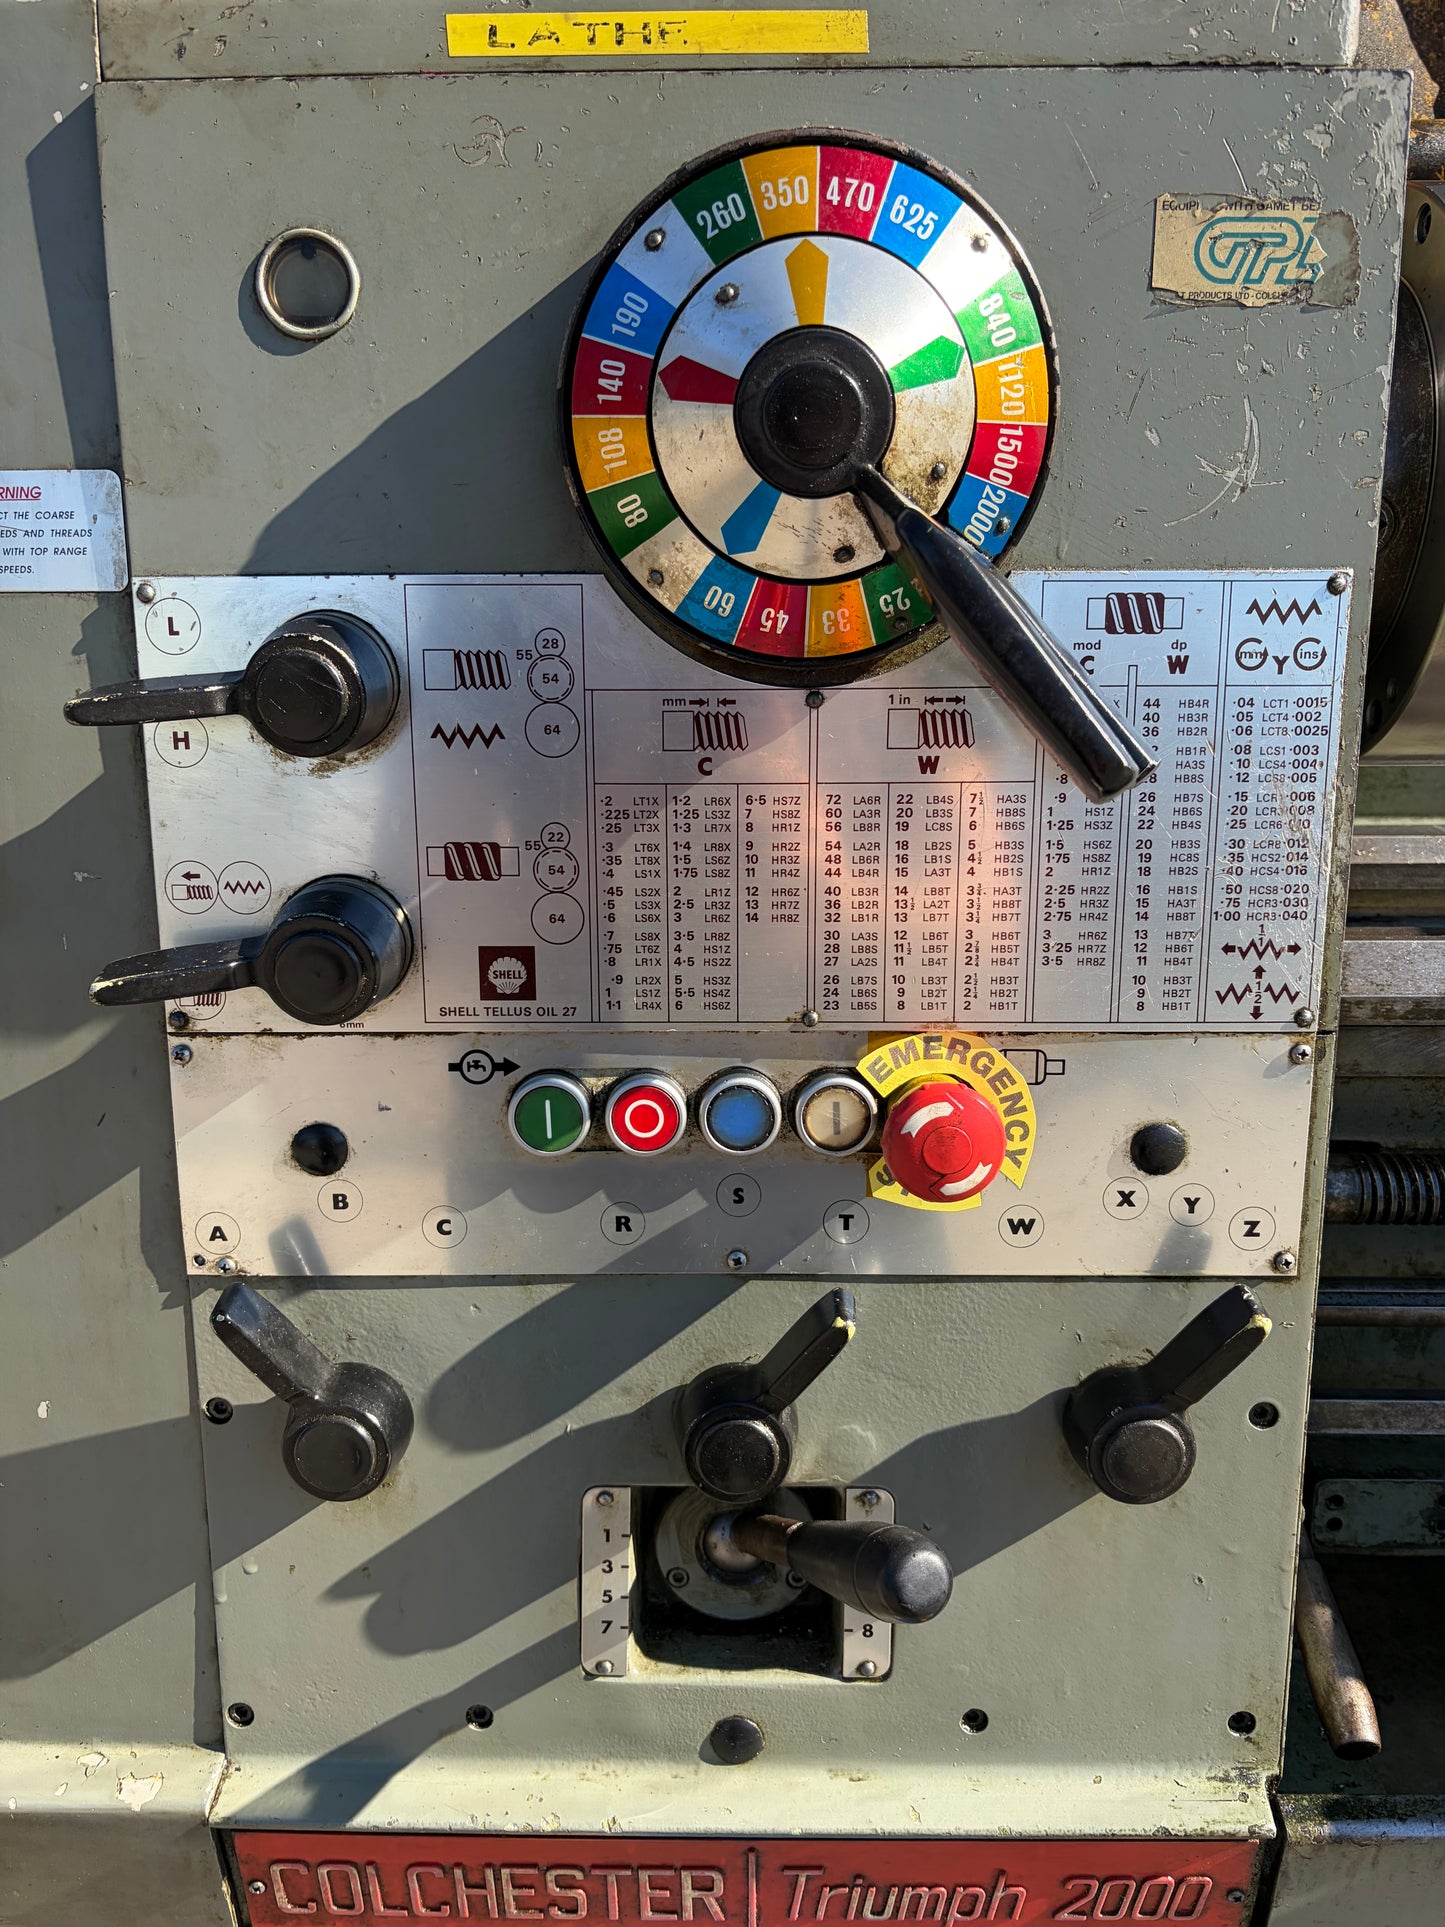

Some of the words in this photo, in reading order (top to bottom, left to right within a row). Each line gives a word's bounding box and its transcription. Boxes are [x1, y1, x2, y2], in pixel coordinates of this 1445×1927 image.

[760, 176, 809, 210] 350
[826, 176, 875, 212] 470
[696, 193, 746, 239] 260
[889, 194, 939, 240] 625
[611, 291, 649, 337] 190
[978, 292, 1017, 347] 840
[597, 359, 626, 405] 140
[997, 356, 1026, 416] 1120
[597, 427, 628, 474] 108
[988, 422, 1024, 487] 1500
[13, 511, 29, 520] THE
[35, 511, 75, 520] COARSE
[616, 493, 649, 529] 80
[963, 484, 1007, 547] 2000
[23, 529, 45, 538] AND
[51, 529, 93, 538] THREADS
[3, 547, 25, 556] WITH
[30, 547, 48, 556] TOP
[53, 547, 87, 556] RANGE
[703, 585, 736, 618] 60
[879, 587, 911, 619] 25
[168, 617, 180, 636] L
[759, 608, 789, 635] 45
[822, 608, 851, 635] 33
[542, 638, 559, 649] 28
[1073, 640, 1101, 650] mod
[1171, 639, 1187, 652] dp
[516, 649, 533, 660] 55
[1300, 649, 1318, 659] ins
[1167, 655, 1189, 674] W
[1272, 656, 1290, 675] Y
[543, 673, 559, 684] 54
[662, 698, 686, 706] mm
[889, 694, 894, 705] 1
[899, 694, 910, 704] in
[1143, 698, 1161, 709] 44
[1179, 699, 1209, 708] HB4R
[1263, 699, 1288, 708] LCT1
[544, 724, 561, 735] 64
[172, 731, 190, 750] H
[698, 757, 712, 776] C
[918, 756, 940, 774] W
[826, 794, 841, 805] 72
[853, 796, 881, 805] LA6R
[897, 794, 913, 804] 22
[927, 795, 953, 805] LB4S
[634, 809, 660, 819] LT2X
[705, 810, 731, 819] LS3Z
[745, 809, 752, 819] 7
[773, 810, 800, 819] HS8Z
[826, 808, 842, 818] 60
[853, 809, 880, 818] LA3R
[969, 807, 976, 817] 7
[996, 808, 1025, 817] HB8S
[1138, 806, 1155, 816] 24
[1173, 807, 1202, 816] HB6S
[634, 823, 660, 832] LT3X
[746, 822, 753, 832] 8
[772, 823, 800, 832] HR1Z
[548, 832, 564, 842] 22
[525, 840, 541, 851] 55
[895, 840, 909, 850] 18
[925, 841, 952, 851] LB2S
[968, 840, 976, 850] 5
[995, 841, 1024, 850] HB3S
[1136, 839, 1152, 849] 20
[1171, 840, 1200, 849] HB3S
[745, 854, 758, 864] 10
[772, 855, 800, 865] HR3Z
[548, 865, 565, 875] 54
[1045, 867, 1053, 877] 2
[1082, 867, 1111, 876] HR1Z
[673, 886, 681, 896] 2
[705, 888, 731, 897] LR1Z
[745, 886, 759, 896] 12
[772, 888, 800, 897] HR6Z
[1249, 885, 1278, 895] HCS8
[549, 914, 565, 923] 64
[674, 912, 682, 922] 3
[705, 914, 730, 923] LR6Z
[745, 913, 759, 922] 14
[772, 914, 800, 923] HR8Z
[824, 913, 841, 923] 32
[852, 913, 879, 922] LB1R
[894, 930, 907, 940] 12
[923, 932, 949, 940] LB6T
[965, 929, 973, 939] 3
[992, 932, 1021, 940] HB6T
[674, 944, 682, 953] 4
[704, 945, 731, 954] HS1Z
[1077, 957, 1106, 966] HR8Z
[493, 970, 524, 979] SHELL
[892, 975, 905, 984] 10
[922, 976, 948, 985] LB3T
[1132, 975, 1146, 985] 10
[1164, 976, 1192, 985] HB3T
[605, 988, 610, 997] 1
[636, 989, 661, 998] LS1Z
[823, 988, 839, 997] 24
[851, 989, 877, 998] LB6S
[636, 1002, 662, 1010] LR4X
[675, 1000, 683, 1010] 6
[704, 1002, 731, 1010] HS6Z
[963, 1001, 971, 1010] 2
[990, 1002, 1018, 1010] HB1T
[439, 1007, 480, 1017] SHELL
[483, 1007, 532, 1016] TELLUS
[536, 1007, 558, 1016] OIL
[562, 1007, 576, 1016] 27
[866, 1035, 1029, 1169] EMERGENCY
[333, 1193, 349, 1210] B
[733, 1188, 744, 1204] S
[1116, 1190, 1136, 1207] X
[1183, 1197, 1201, 1214] Y
[436, 1219, 452, 1235] C
[615, 1216, 632, 1232] R
[839, 1214, 854, 1230] T
[1007, 1218, 1036, 1235] W
[209, 1226, 228, 1241] A
[1243, 1221, 1260, 1237] Z
[604, 1529, 610, 1543] 1
[602, 1560, 613, 1574] 3
[602, 1590, 613, 1603] 5
[601, 1620, 613, 1634] 7
[862, 1624, 873, 1638] 8
[269, 1860, 726, 1922] COLCHESTER
[782, 1867, 1028, 1927] Triumph
[1055, 1875, 1213, 1922] 2000
